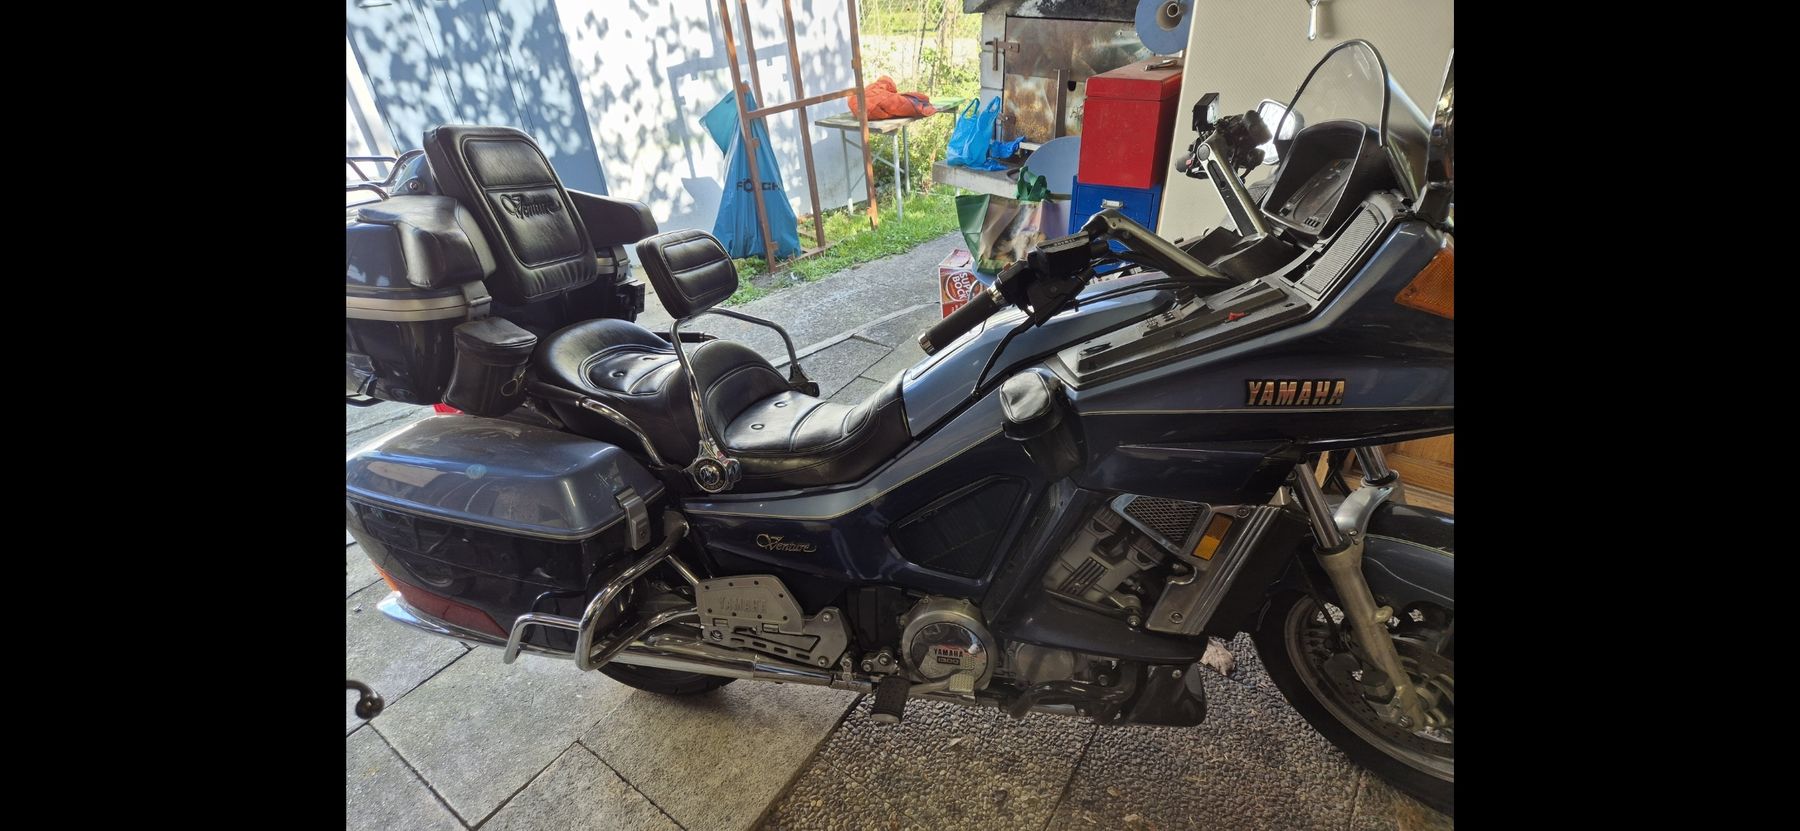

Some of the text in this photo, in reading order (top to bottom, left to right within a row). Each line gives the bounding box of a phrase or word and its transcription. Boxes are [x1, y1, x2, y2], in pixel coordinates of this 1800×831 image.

[952, 275, 968, 300] BOCK
[1247, 380, 1346, 407] YAMAHA
[756, 533, 817, 553] Venture
[933, 647, 964, 658] YAMAHA
